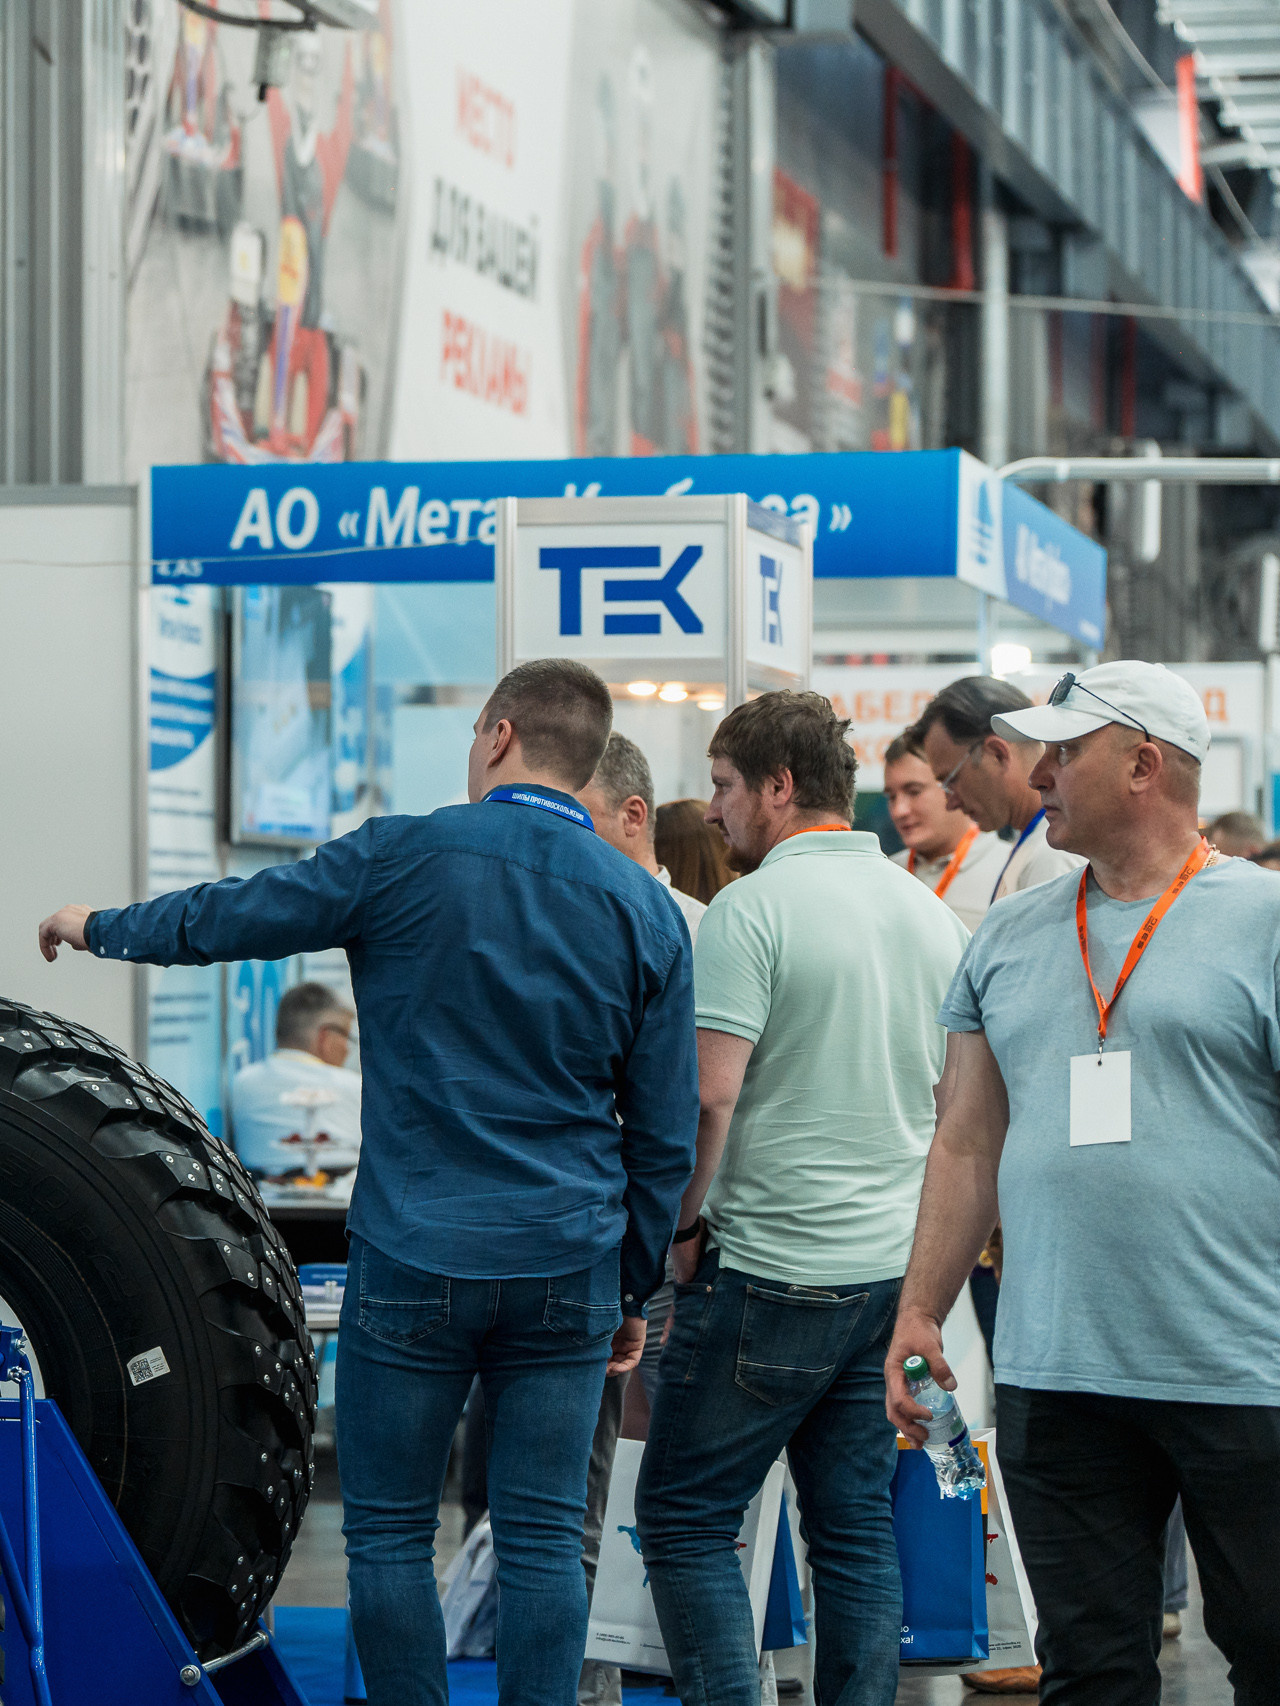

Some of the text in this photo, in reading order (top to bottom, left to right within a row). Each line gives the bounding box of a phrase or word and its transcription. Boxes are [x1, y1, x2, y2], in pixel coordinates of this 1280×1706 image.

[229, 486, 320, 550] АО
[511, 792, 585, 822] ШИПЫ ПРОТИВОСКОЛЬЖЕНИЯ
